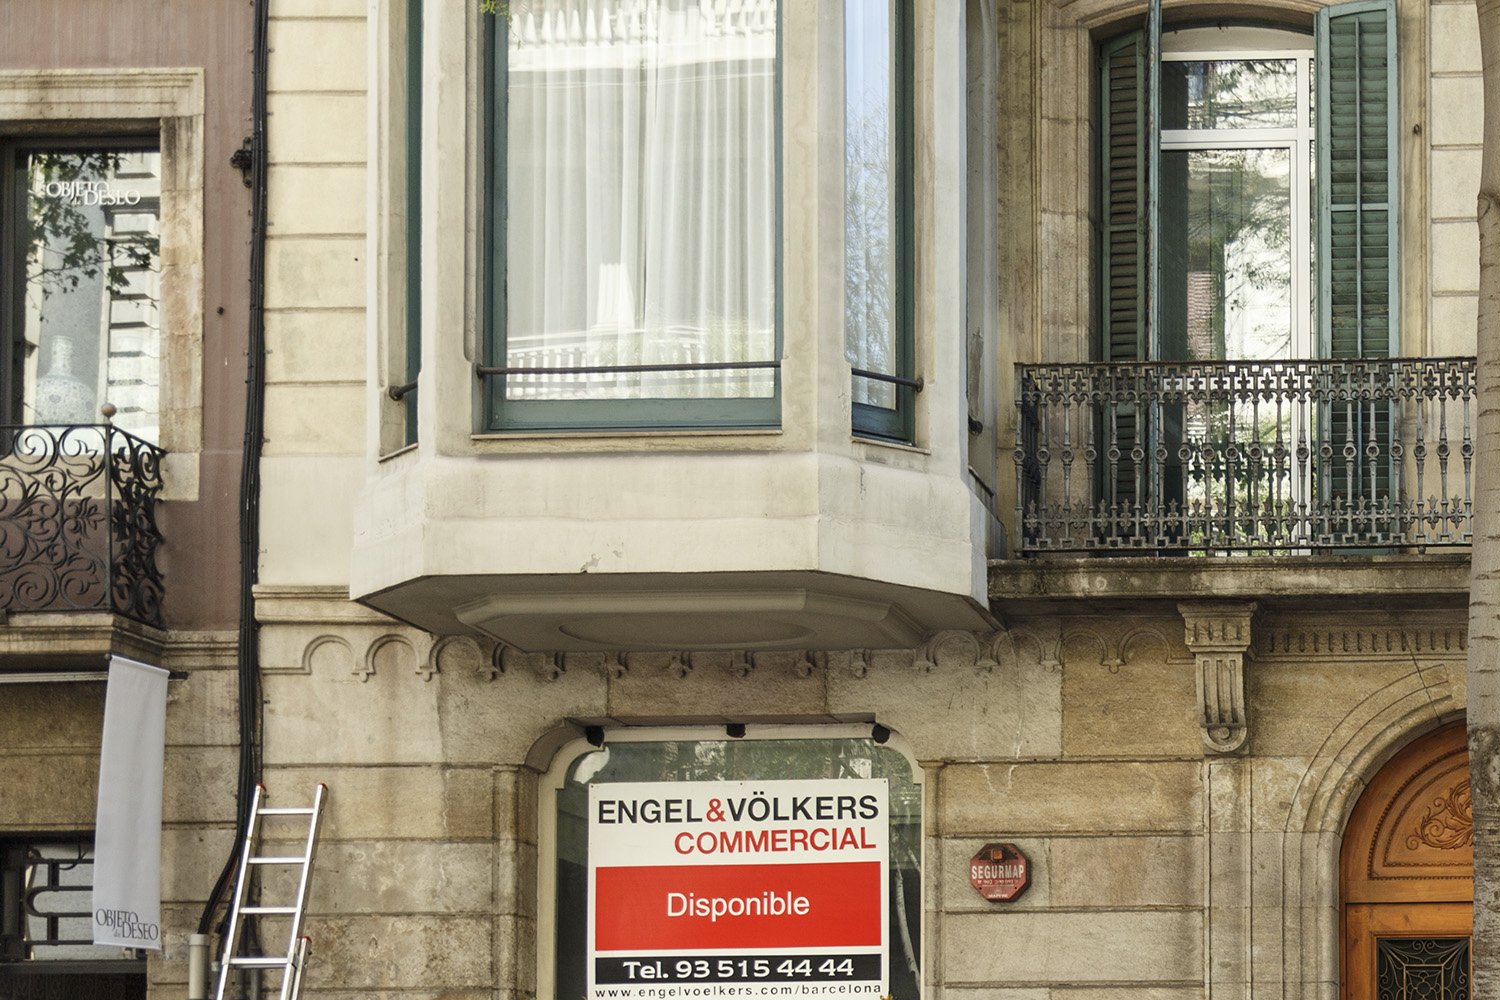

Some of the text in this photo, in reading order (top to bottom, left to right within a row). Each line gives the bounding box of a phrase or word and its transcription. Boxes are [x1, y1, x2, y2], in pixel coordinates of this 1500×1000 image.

[46, 181, 110, 200] OBJETO
[84, 189, 141, 206] DESEO
[674, 827, 877, 854] COMMERCIAL
[971, 864, 1024, 880] SEGURMAP
[666, 890, 811, 922] Disponible
[95, 908, 139, 929] OBJETO
[122, 921, 159, 941] DESEO
[623, 956, 855, 979] Tel. 93 515 44 44
[595, 983, 882, 999] www.engelvoelkers.com/barcelona
